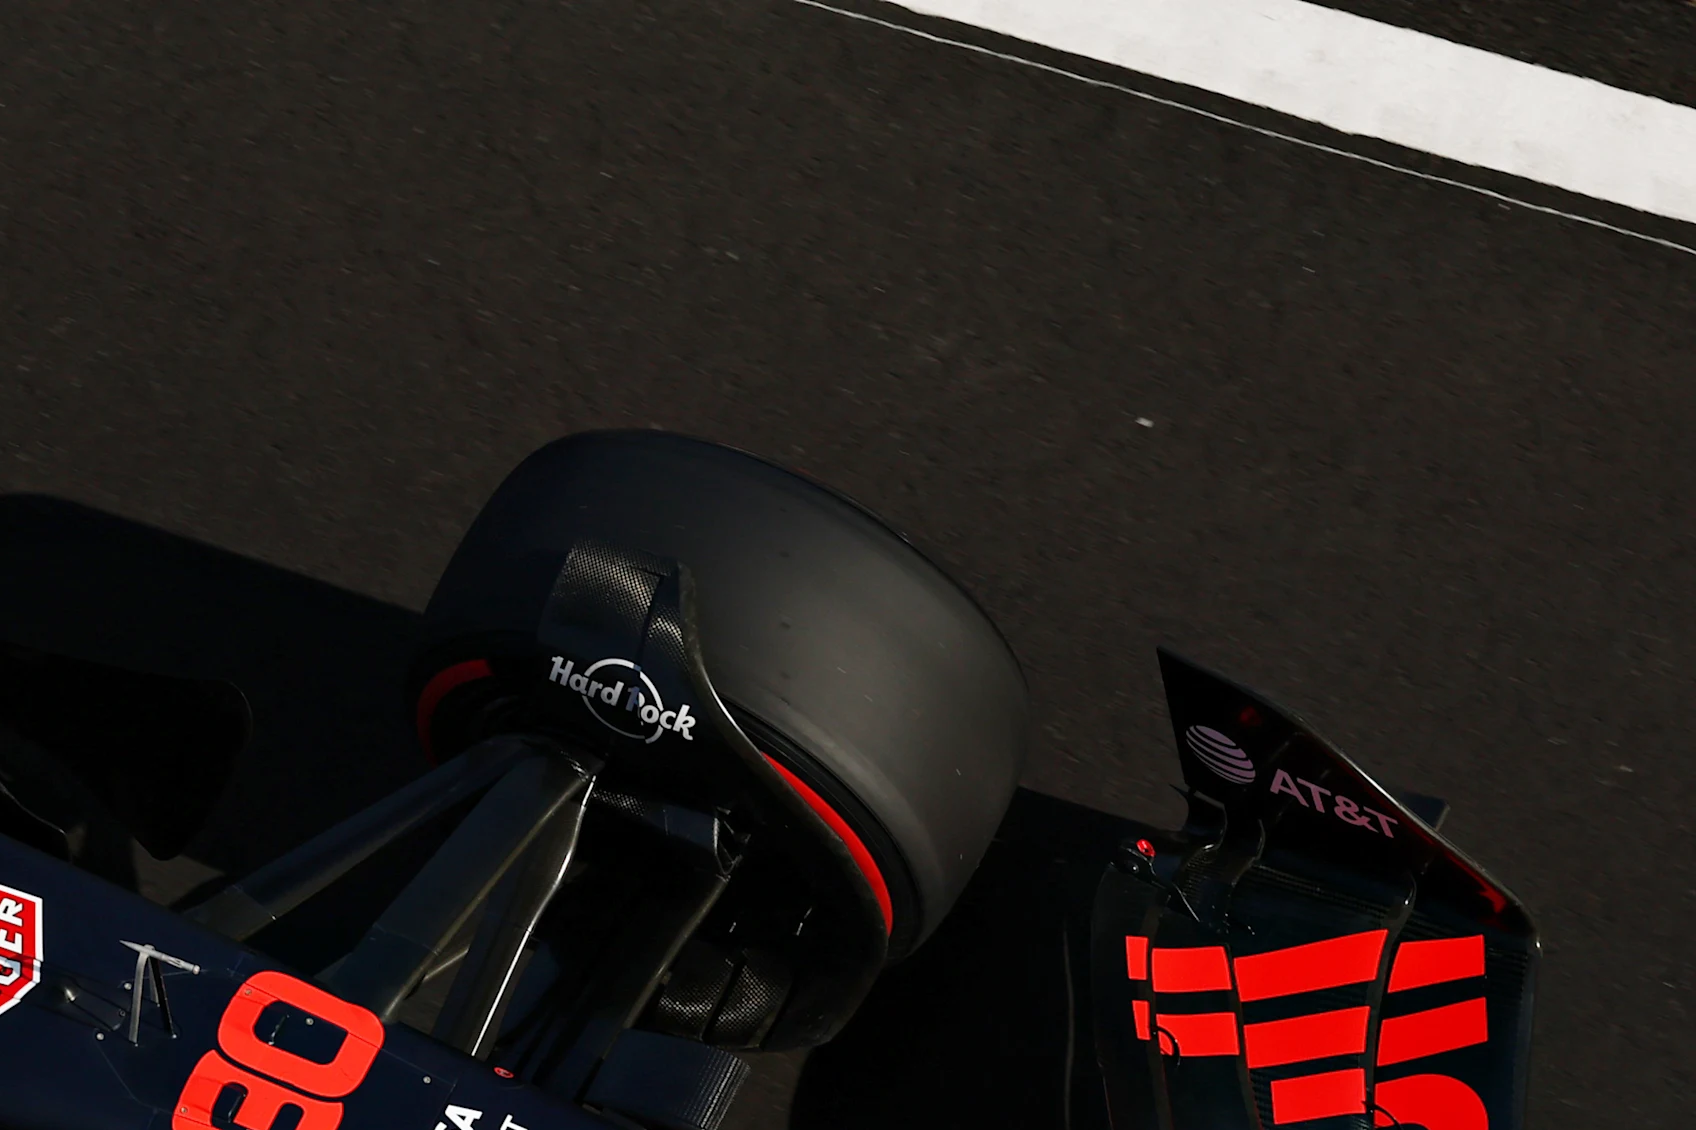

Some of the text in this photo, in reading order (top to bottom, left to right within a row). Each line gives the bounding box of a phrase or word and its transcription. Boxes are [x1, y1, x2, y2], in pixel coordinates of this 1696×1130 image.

[550, 656, 696, 741] Hard Rock
[1269, 768, 1398, 838] AT&T
